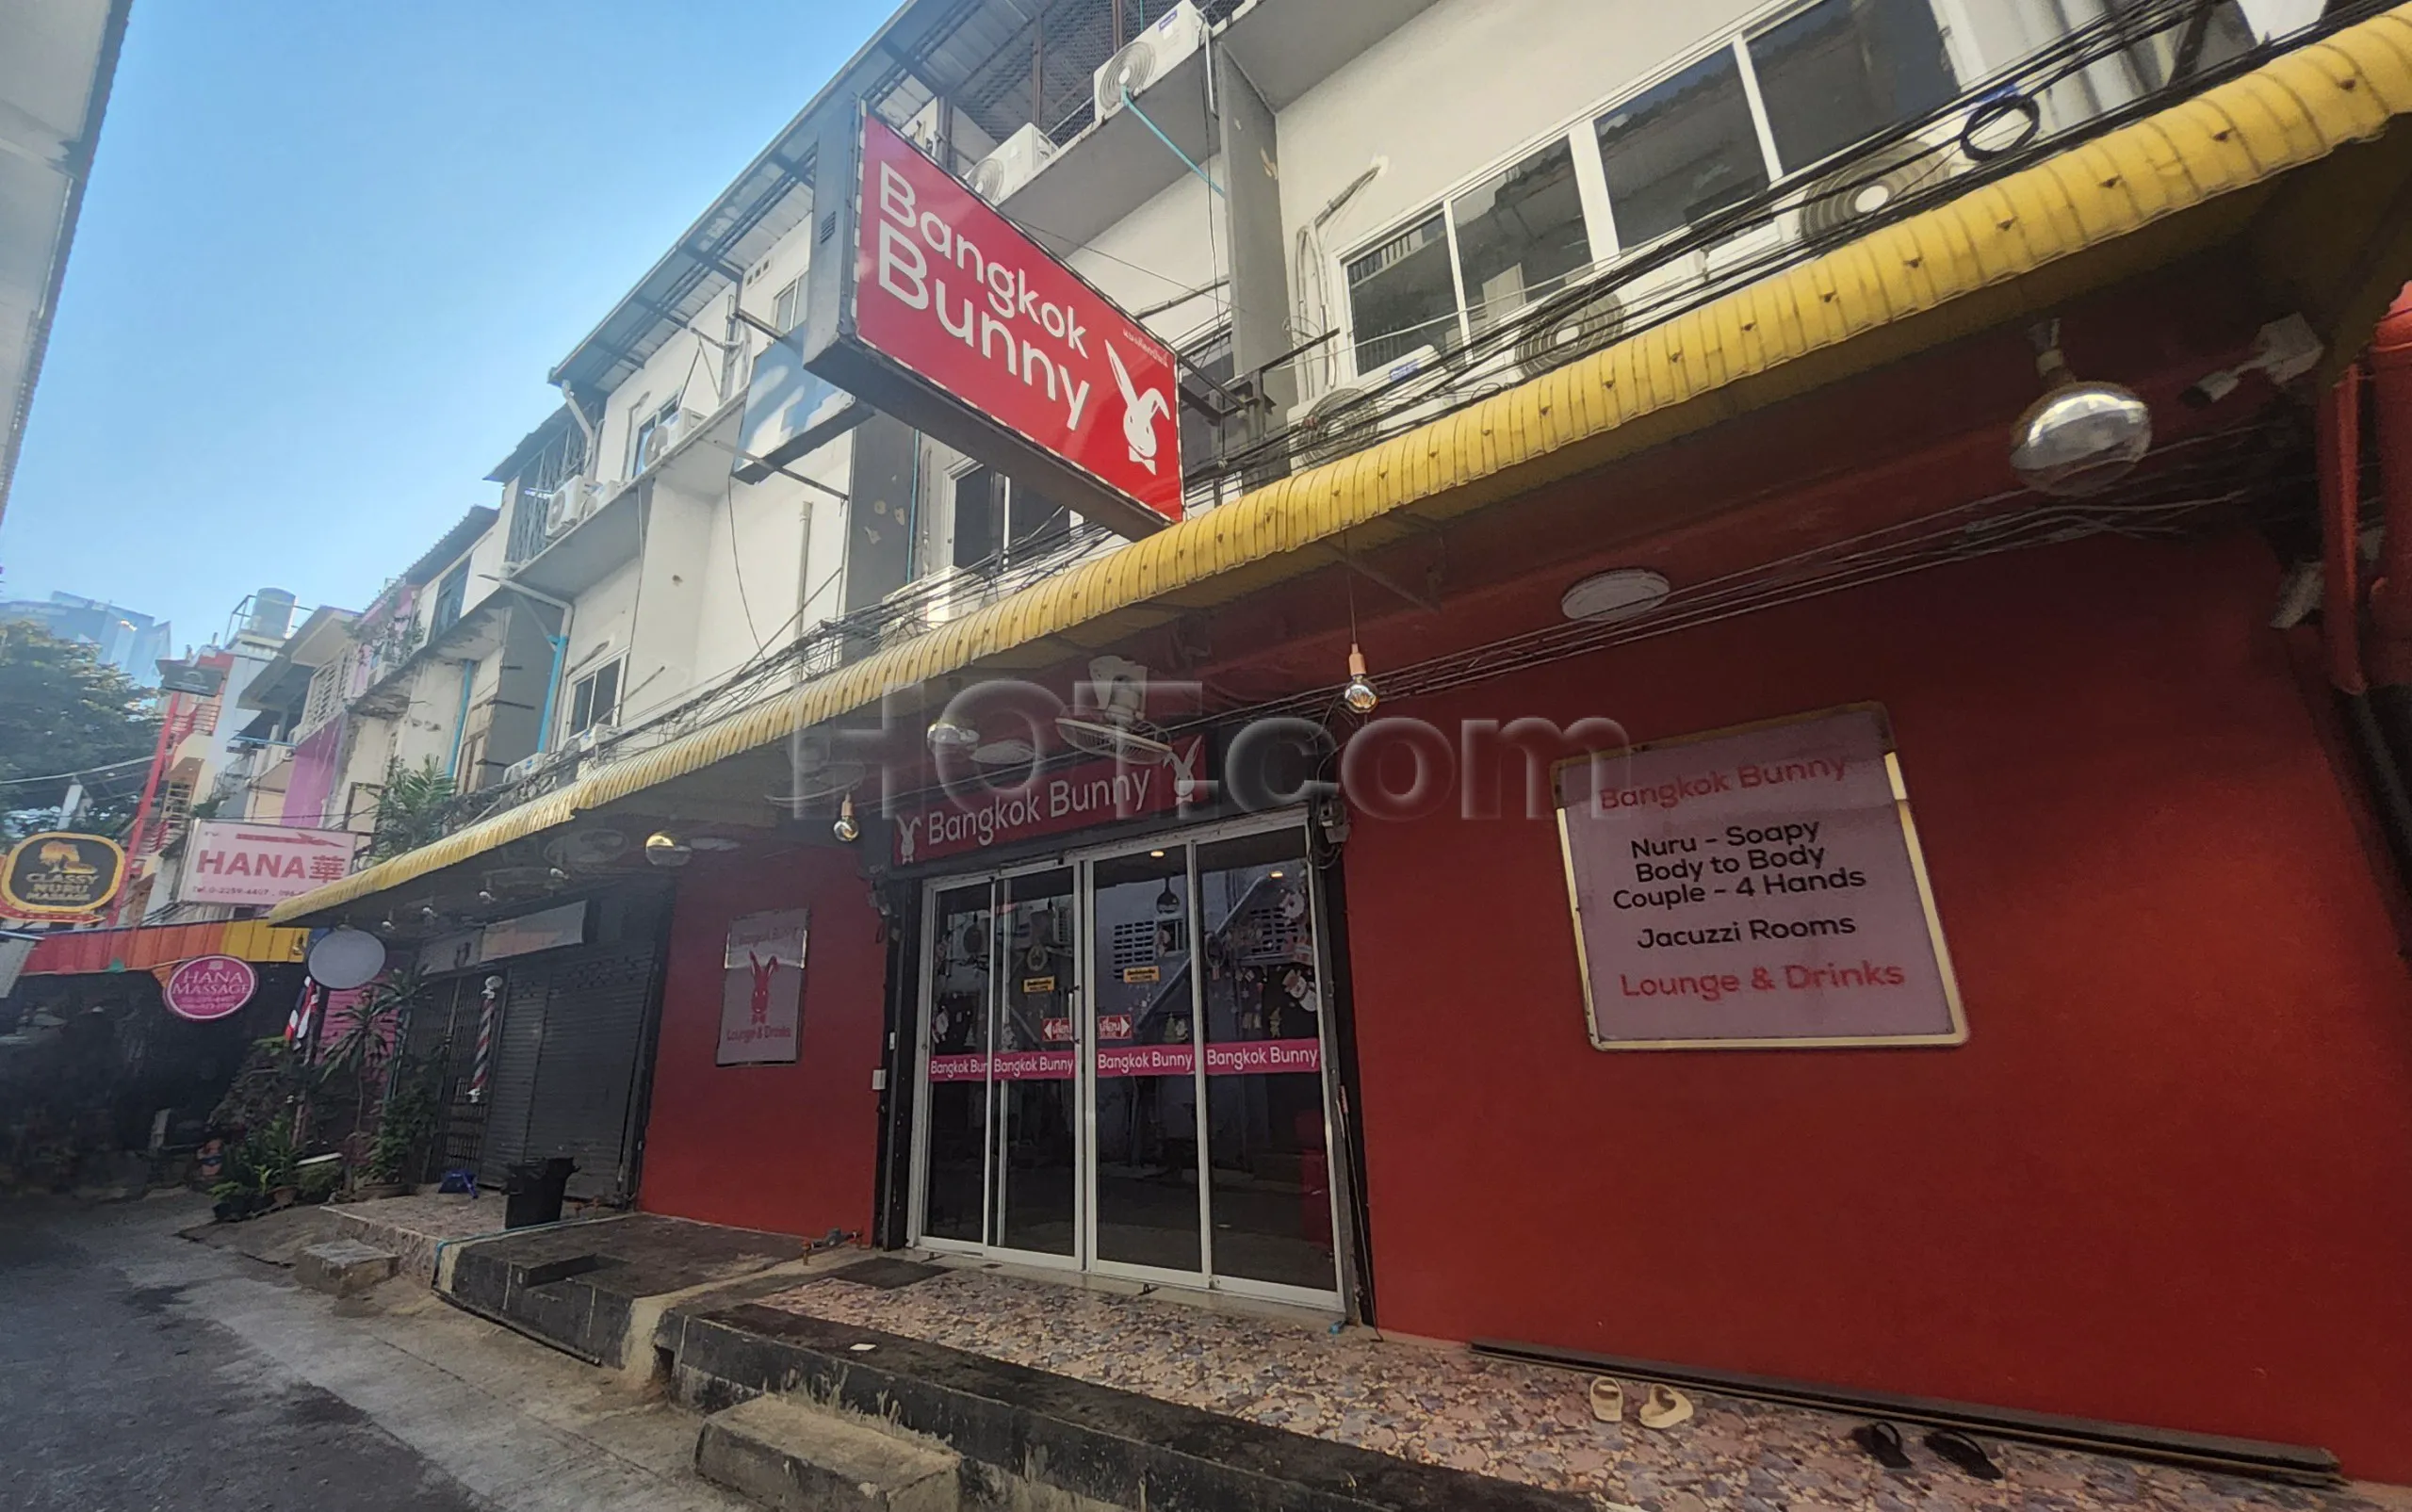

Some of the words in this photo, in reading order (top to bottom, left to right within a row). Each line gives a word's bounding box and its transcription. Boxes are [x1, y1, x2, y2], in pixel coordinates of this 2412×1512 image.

[880, 160, 1089, 359] Bangkok
[878, 218, 1090, 431] Bunny
[1600, 771, 1732, 810] Bangkok
[1737, 757, 1849, 789] Bunny
[928, 788, 1041, 846] Bangkok
[1050, 768, 1151, 818] Bunny
[1631, 837, 1697, 858] Nuru
[1725, 821, 1820, 847] Soapy
[196, 850, 306, 879] HANA
[1635, 858, 1703, 884] Body
[1710, 855, 1741, 874] to
[1747, 844, 1825, 870] Body
[1612, 883, 1706, 911] Couple
[1736, 876, 1755, 897] 4
[1763, 866, 1866, 896] Hands
[1637, 921, 1741, 950] Jacuzzi
[1748, 916, 1857, 941] Rooms
[182, 970, 244, 984] HANA
[1620, 972, 1740, 1002] Lounge
[1751, 967, 1776, 990] &
[1785, 960, 1906, 990] Drinks
[930, 1060, 969, 1079] Bangkok
[994, 1057, 1037, 1078] Bangkok
[1039, 1055, 1073, 1075] Bunny
[1098, 1052, 1149, 1074] Bangkok
[1151, 1050, 1193, 1071] Bunny
[1207, 1047, 1266, 1070] Bangkok
[1270, 1046, 1319, 1067] Bunny
